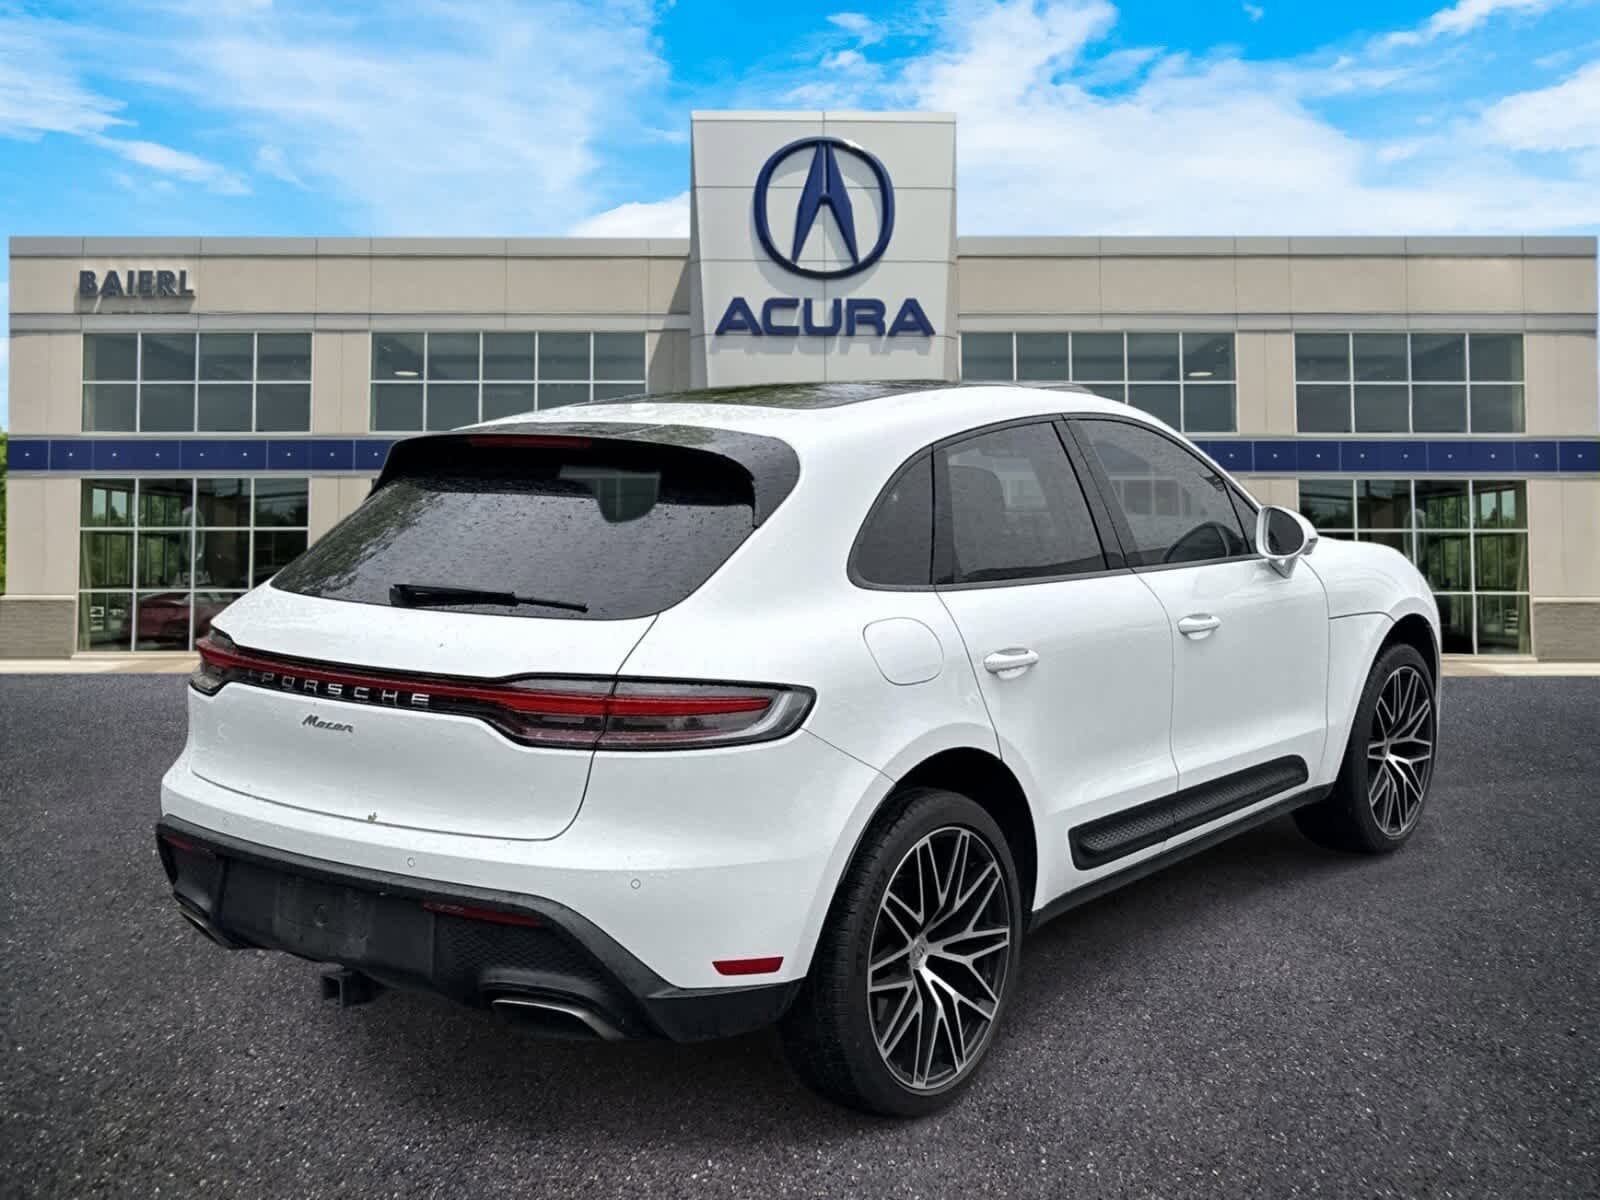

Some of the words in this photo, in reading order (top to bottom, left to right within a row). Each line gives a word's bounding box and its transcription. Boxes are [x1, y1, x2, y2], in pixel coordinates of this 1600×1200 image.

[80, 270, 194, 297] BAIERL
[715, 297, 936, 336] ACURA
[261, 672, 430, 705] PORSCHE
[302, 714, 353, 733] Macan
